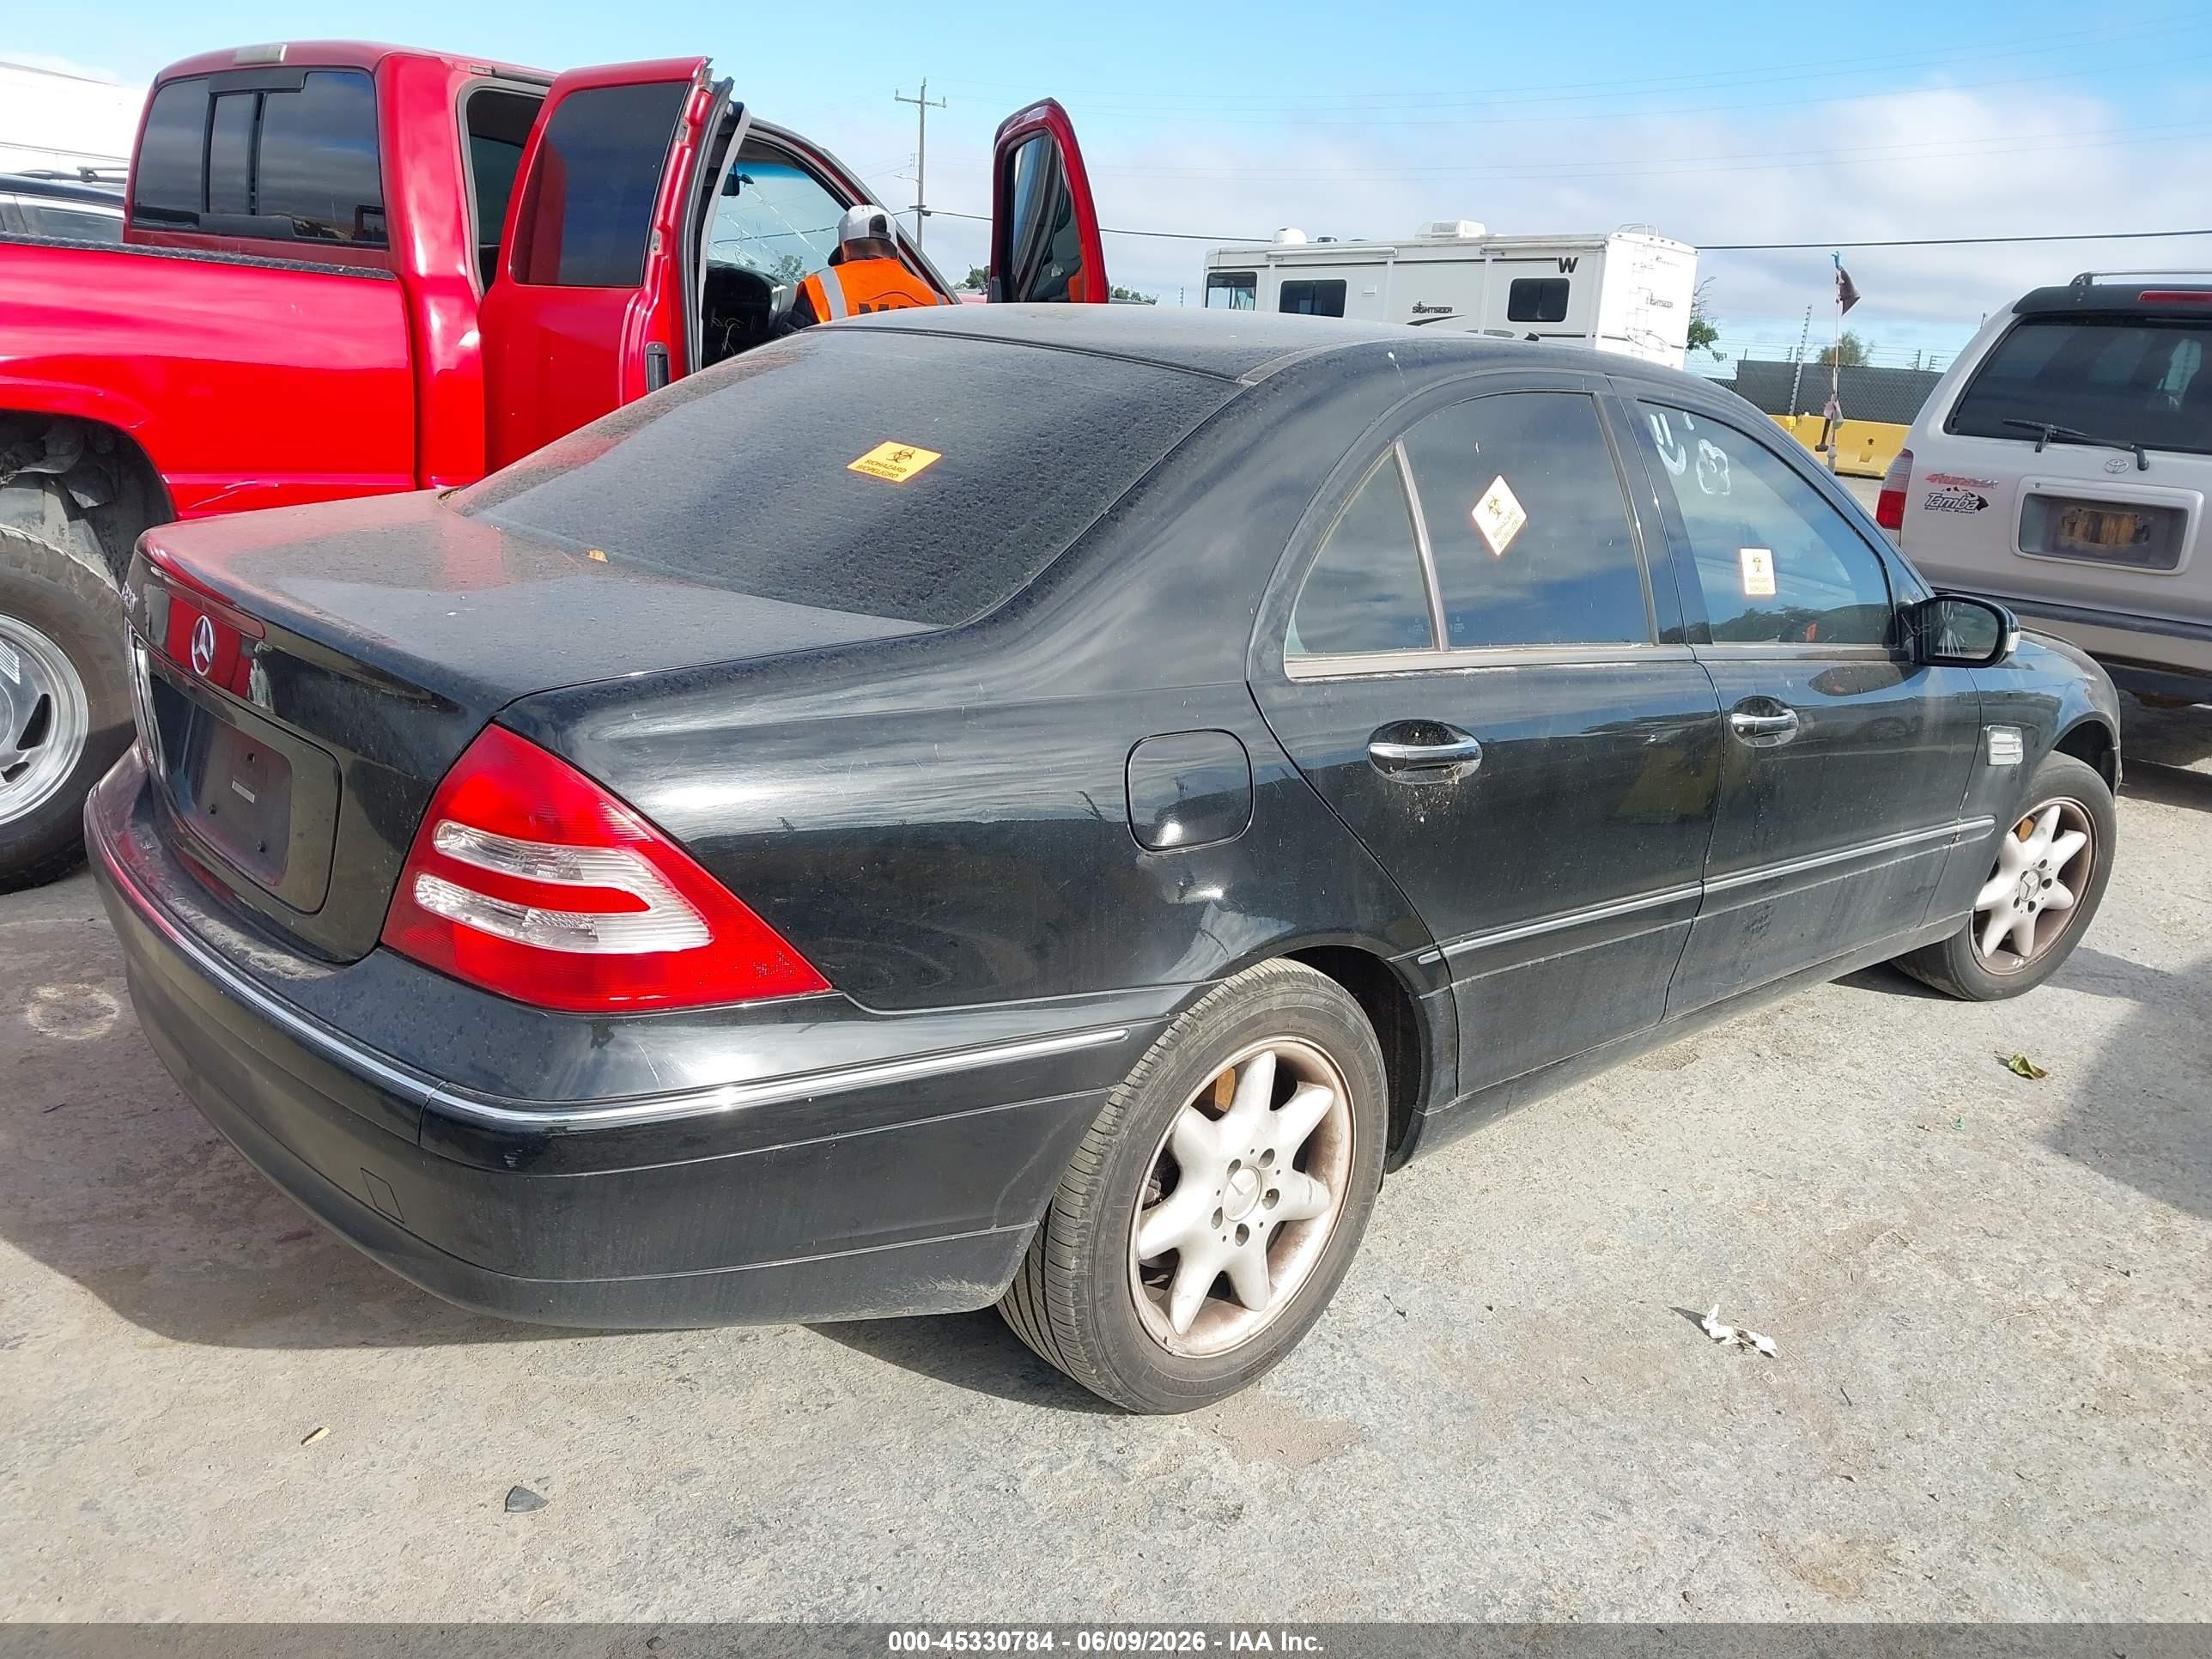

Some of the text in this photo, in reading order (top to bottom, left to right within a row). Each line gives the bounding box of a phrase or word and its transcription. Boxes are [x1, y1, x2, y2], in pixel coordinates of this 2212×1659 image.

[1558, 257, 1579, 273] W
[1412, 303, 1453, 314] SIGHTSEER
[1924, 492, 1979, 511] Tamba
